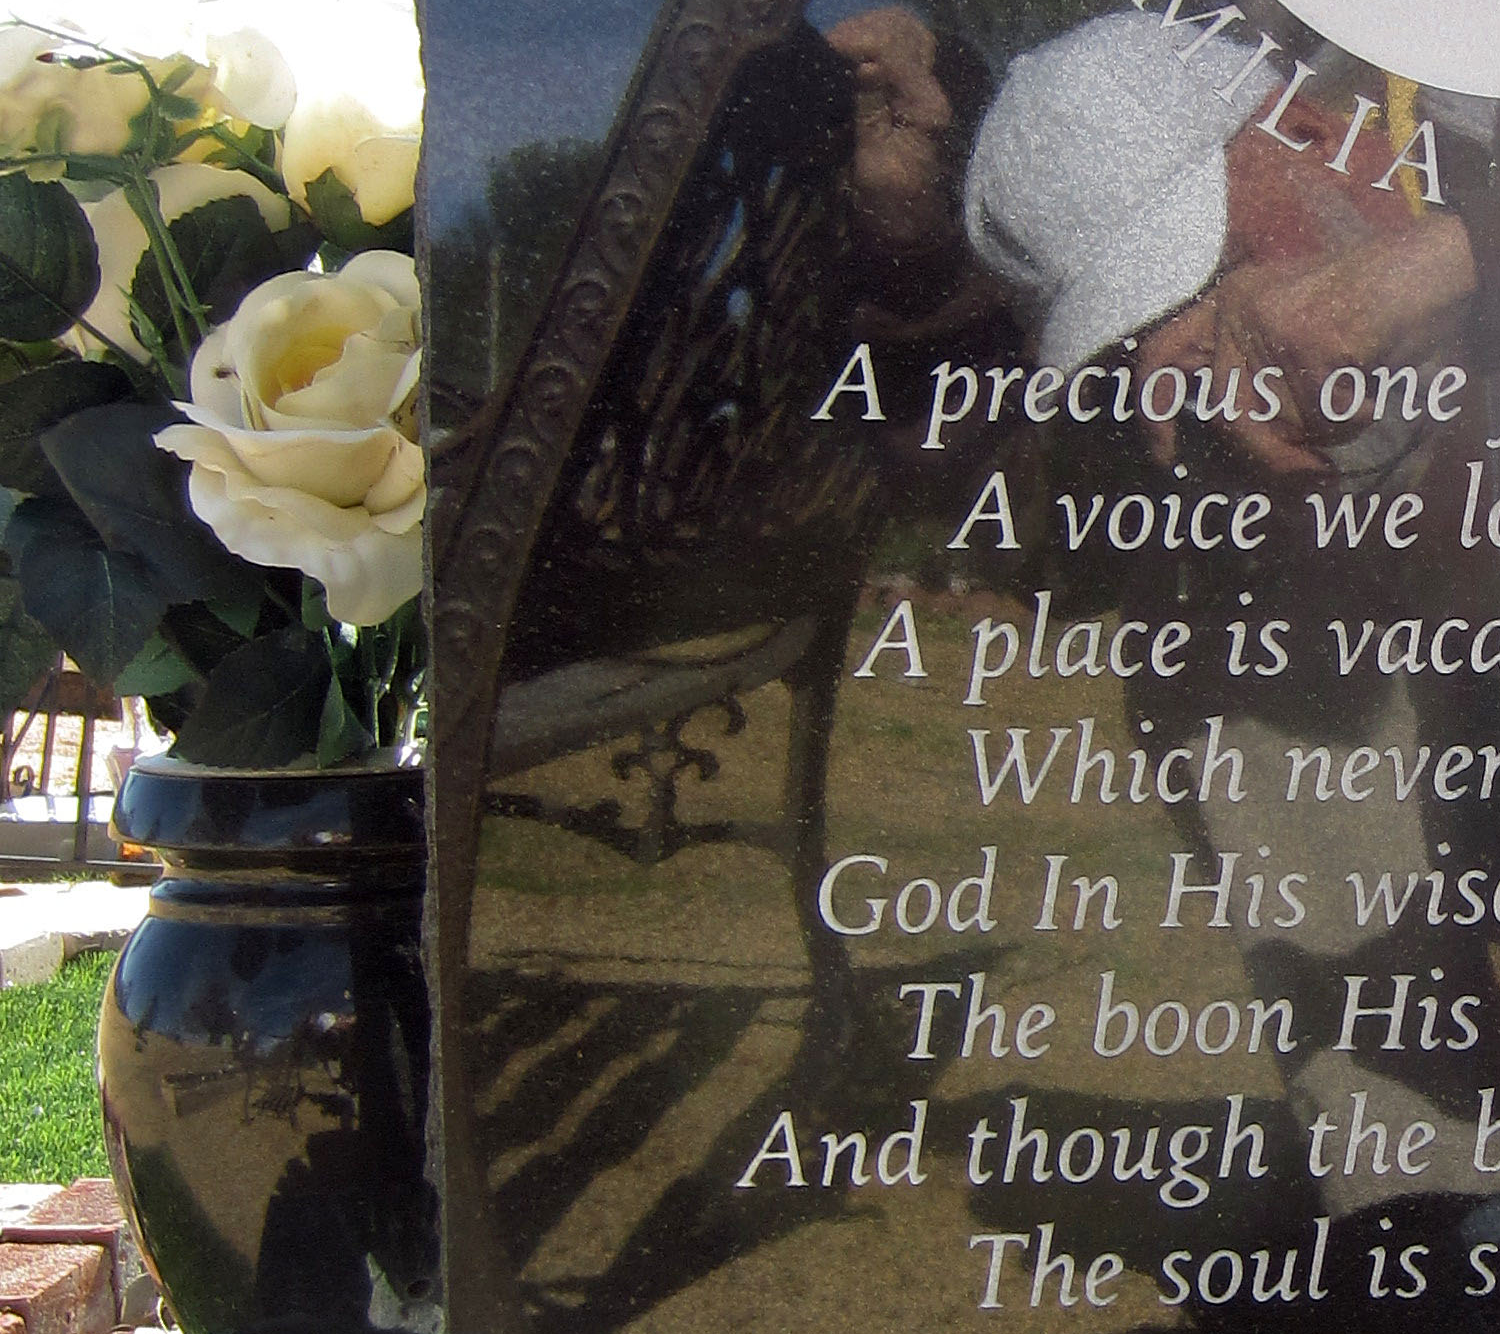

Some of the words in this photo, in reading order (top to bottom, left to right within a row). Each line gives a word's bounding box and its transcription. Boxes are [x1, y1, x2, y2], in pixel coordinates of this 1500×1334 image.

[811, 344, 886, 420] A
[921, 337, 1283, 450] precious
[1321, 367, 1466, 421] one
[947, 472, 1021, 548] A
[1057, 465, 1271, 550] voice
[1306, 494, 1423, 548] we
[854, 600, 927, 676] A
[963, 591, 1190, 704] place
[1227, 592, 1290, 675] is
[968, 716, 1245, 805] Which
[819, 846, 996, 934] God
[1035, 856, 1122, 929] In
[1162, 847, 1307, 927] His
[900, 973, 1055, 1058] The
[1094, 972, 1296, 1056] boon
[1334, 968, 1480, 1050] His
[736, 1100, 927, 1187] And
[968, 1094, 1268, 1207] though
[1309, 1092, 1435, 1176] the
[970, 1224, 1123, 1308] The
[1158, 1218, 1330, 1305] soul
[1369, 1218, 1429, 1298] is
